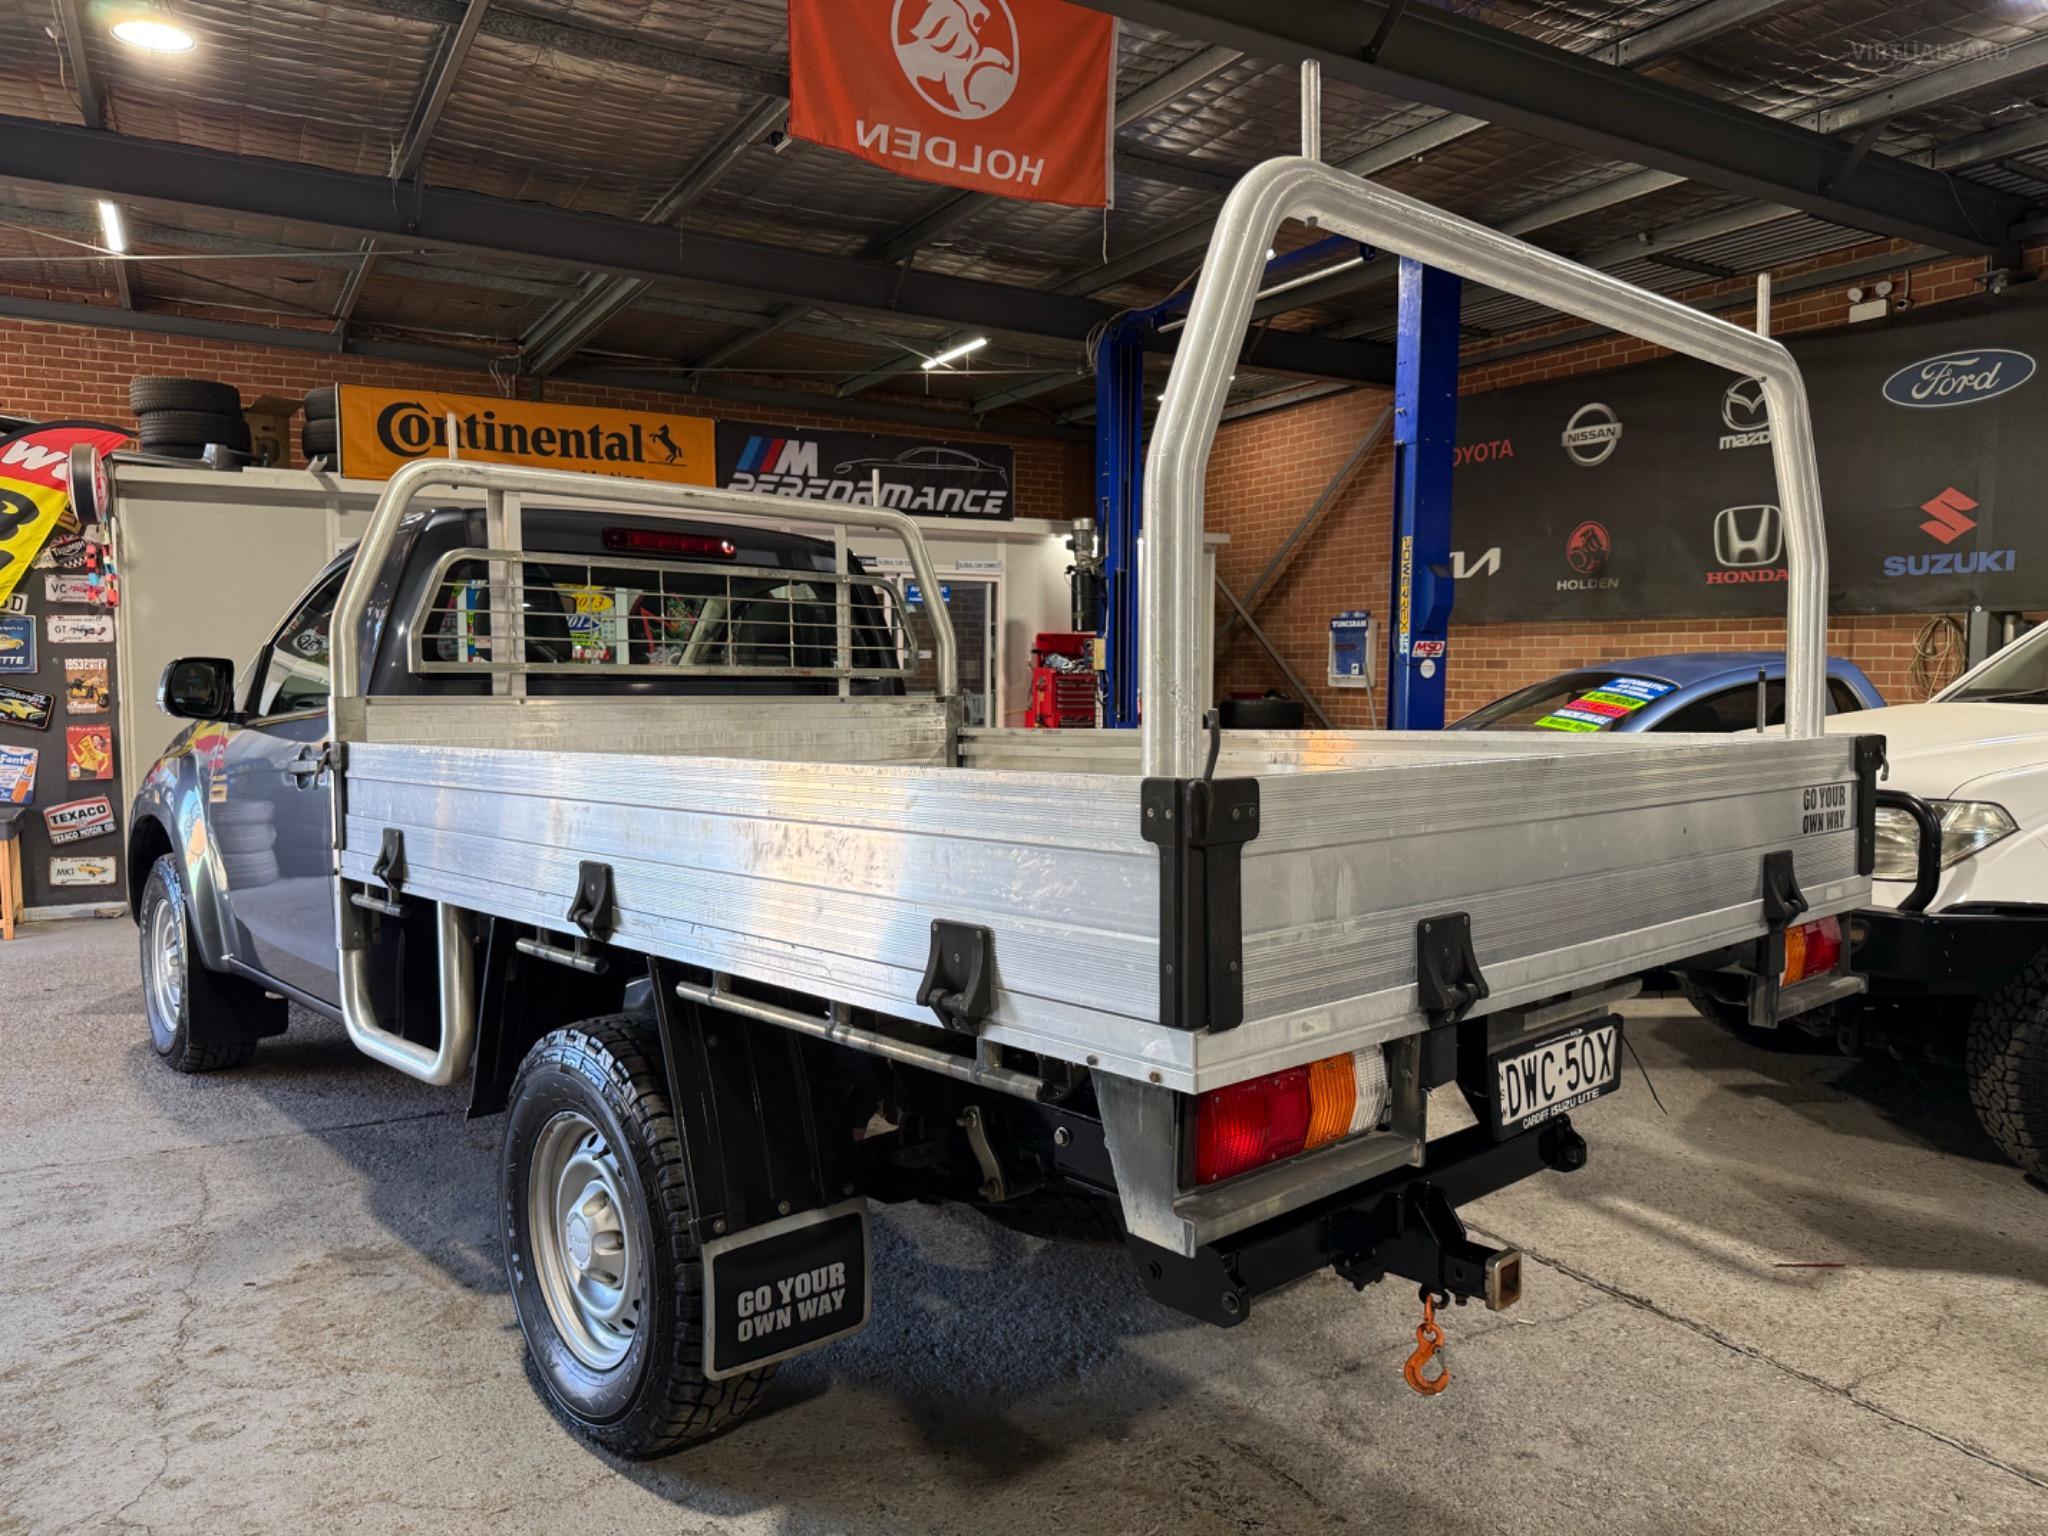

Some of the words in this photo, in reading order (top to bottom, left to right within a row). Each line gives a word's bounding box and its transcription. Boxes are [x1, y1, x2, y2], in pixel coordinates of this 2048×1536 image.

[1912, 357, 2002, 399] Ford
[377, 402, 646, 463] Continental
[1567, 427, 1616, 443] NISSAN
[1452, 439, 1514, 467] OYOTA
[726, 472, 1008, 514] PERFORMANCE
[1883, 550, 2016, 576] SUZUKI
[1556, 578, 1619, 591] HOLDEN
[1706, 568, 1788, 585] HONDA
[1415, 642, 1444, 652] MSD
[1803, 788, 1817, 811] GO
[1819, 785, 1845, 808] YOUR
[49, 804, 107, 825] TEXACO
[1803, 812, 1824, 834] OWN
[1826, 809, 1845, 830] WAY
[1522, 1108, 1550, 1129] CARDIFF
[1550, 1097, 1577, 1117] ISUZU
[1578, 1088, 1600, 1104] UTE
[738, 1285, 772, 1318] GO
[777, 1262, 846, 1305] YOUR
[738, 1306, 792, 1342] OWN
[797, 1288, 846, 1322] WAY
